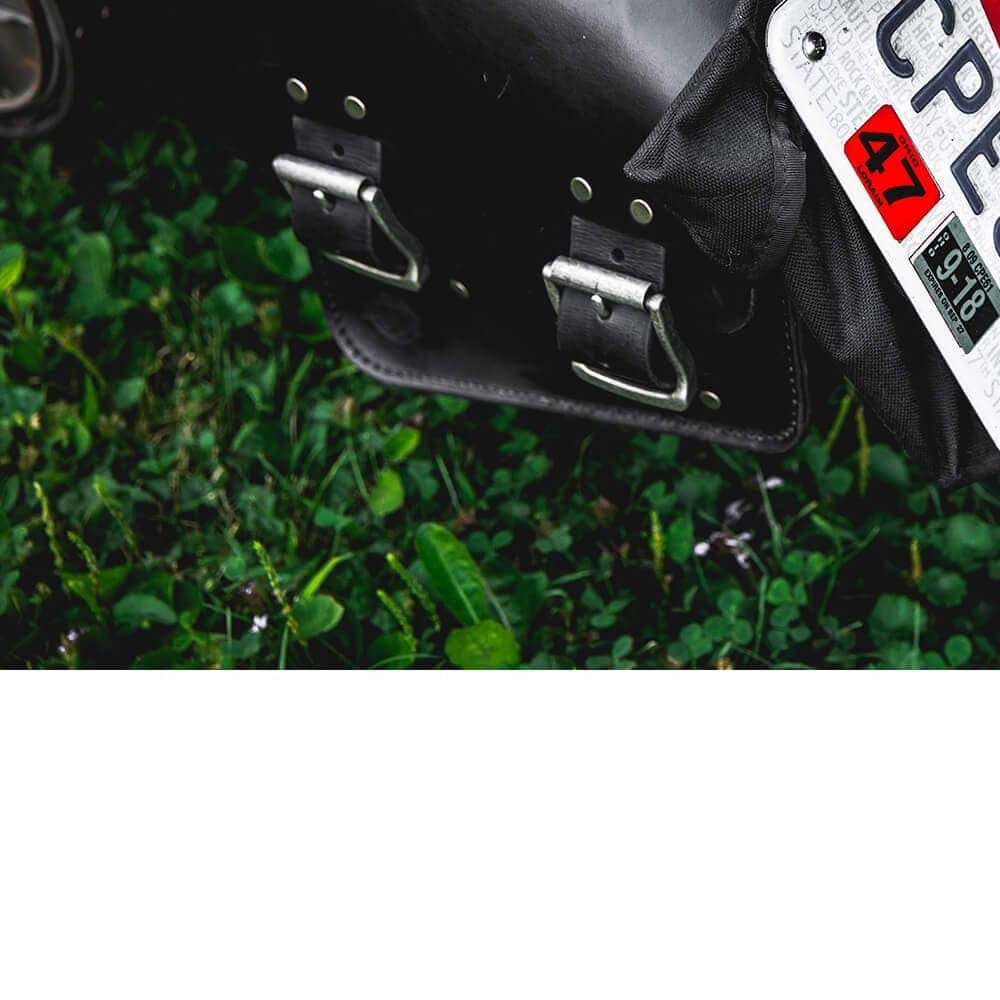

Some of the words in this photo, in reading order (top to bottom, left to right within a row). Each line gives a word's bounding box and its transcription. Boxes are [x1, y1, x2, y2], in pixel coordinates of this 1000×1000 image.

[823, 102, 851, 142] 180
[858, 131, 925, 204] 47
[936, 249, 985, 320] 9-18
[972, 261, 994, 294] CPE61
